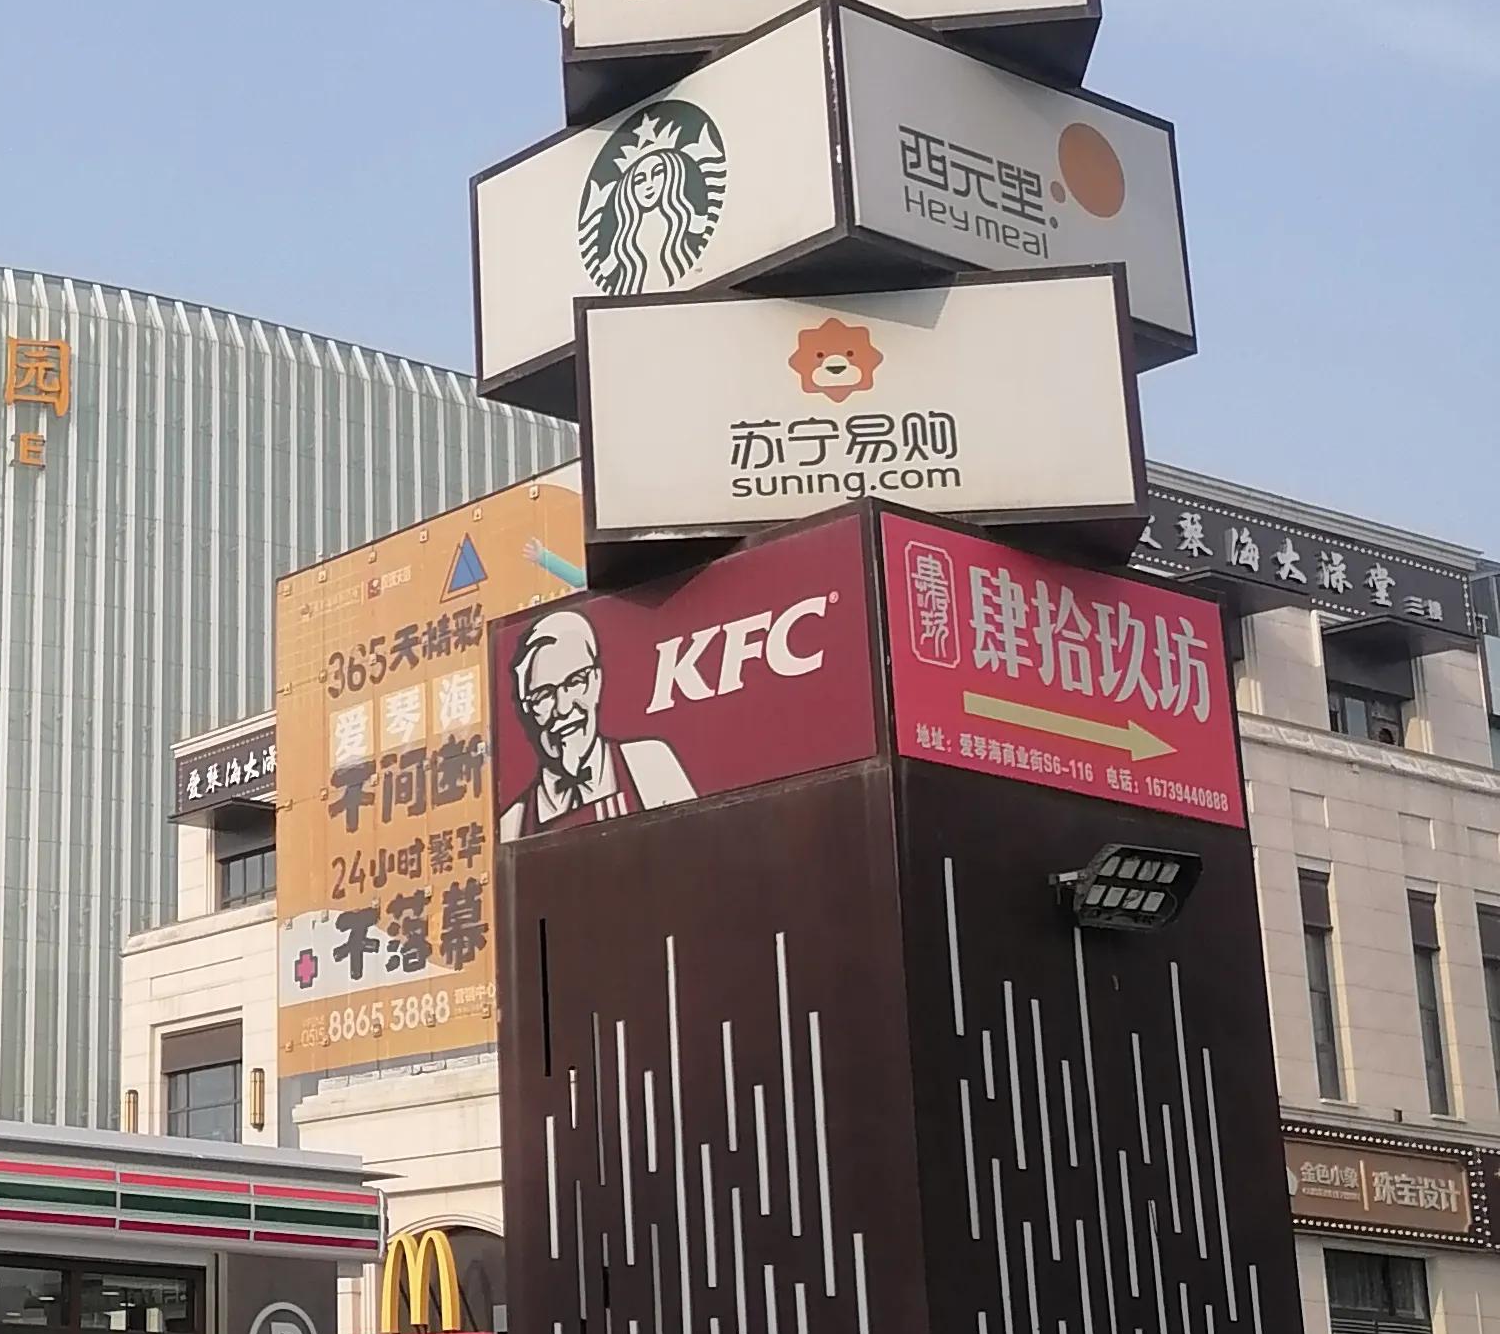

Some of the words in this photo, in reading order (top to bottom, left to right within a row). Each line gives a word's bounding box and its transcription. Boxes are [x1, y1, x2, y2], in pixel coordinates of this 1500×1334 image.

[899, 124, 1046, 225] 西元里
[729, 411, 959, 470] 苏宁易购
[731, 466, 962, 501] suning.com
[327, 603, 485, 700] 365天精彩
[645, 596, 828, 715] KFC
[968, 565, 1211, 724] 肆拾玖坊
[332, 671, 478, 763] 爱琴海
[328, 733, 486, 834] 不间断
[331, 822, 486, 900] 24小时繁华
[333, 877, 489, 980] 不落幕
[328, 1002, 384, 1043] 8865
[389, 990, 450, 1032] 3888
[1300, 1161, 1360, 1189] 金色小象
[1372, 1171, 1461, 1213] 珠宝设计
